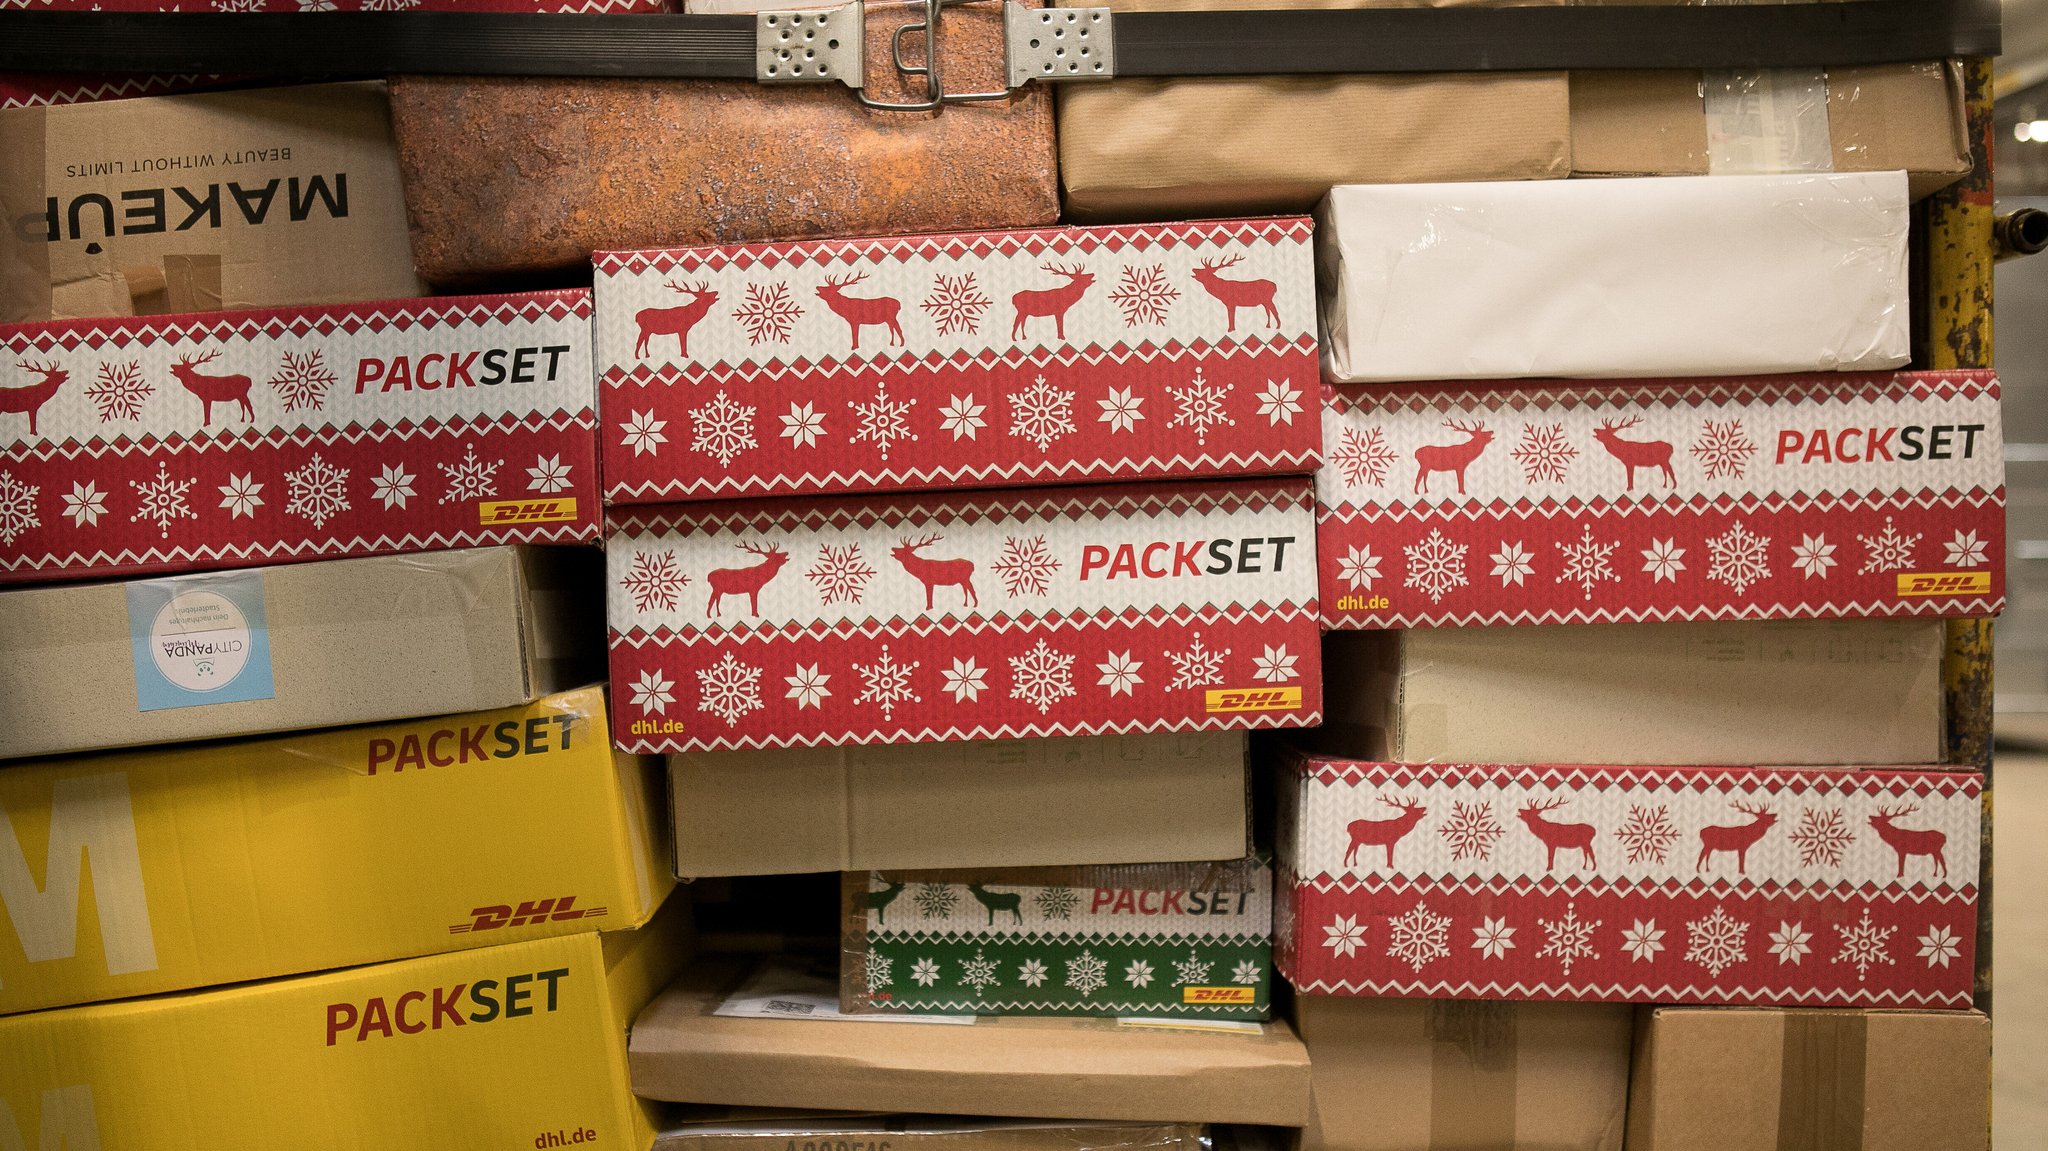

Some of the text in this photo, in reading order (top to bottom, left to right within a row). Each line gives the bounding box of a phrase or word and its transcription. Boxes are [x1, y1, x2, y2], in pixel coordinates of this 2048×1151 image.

[66, 148, 291, 178] BEAUTY WITHOUT LIMITS
[354, 344, 571, 395] PACKSET
[1775, 424, 1985, 465] PACKSET
[490, 502, 568, 522] DHL
[1079, 536, 1296, 581] PACKSET
[1909, 576, 1981, 593] DHL
[1337, 594, 1390, 610] dhl.de
[1217, 691, 1290, 709] DHL
[630, 718, 685, 735] dhl.de
[367, 713, 581, 776] PACKSET
[466, 896, 591, 932] DHL
[1091, 887, 1255, 916] PACKSET
[326, 967, 570, 1047] PACKSET
[1192, 989, 1248, 1001] DHL
[535, 1127, 597, 1150] dhl.de
